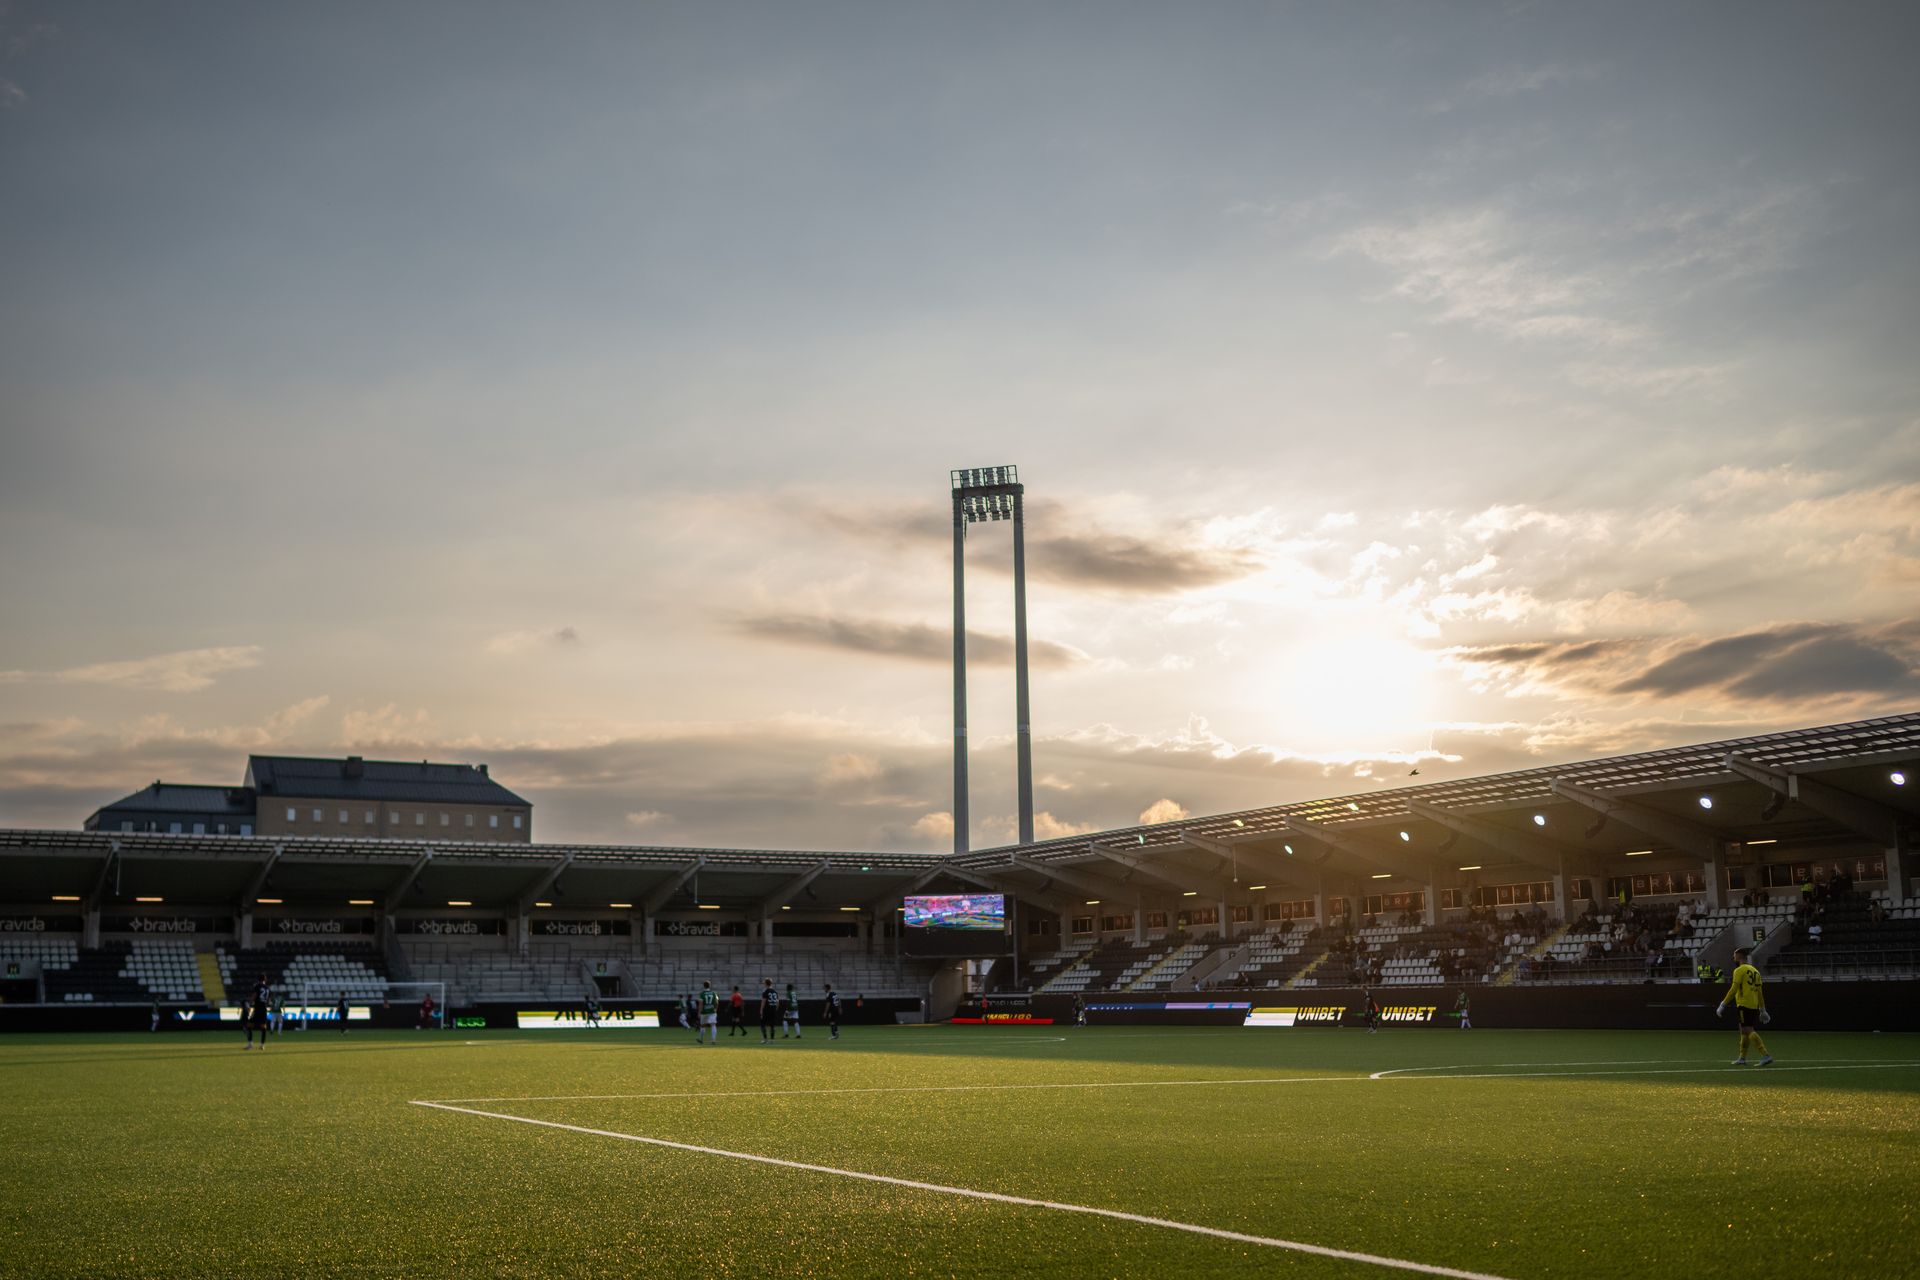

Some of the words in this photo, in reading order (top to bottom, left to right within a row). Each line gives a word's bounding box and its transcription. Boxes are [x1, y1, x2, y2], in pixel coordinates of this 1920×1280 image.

[0, 916, 45, 931] ravida
[143, 917, 196, 932] bravida
[292, 919, 340, 933] bravida
[431, 920, 478, 934] bravida
[558, 921, 601, 934] bravida
[679, 921, 720, 935] bravida
[1756, 931, 1762, 940] E
[705, 994, 714, 1004] 17
[767, 992, 777, 1003] 33
[1297, 1006, 1346, 1021] UNIBET
[1381, 1006, 1436, 1022] UNIBET
